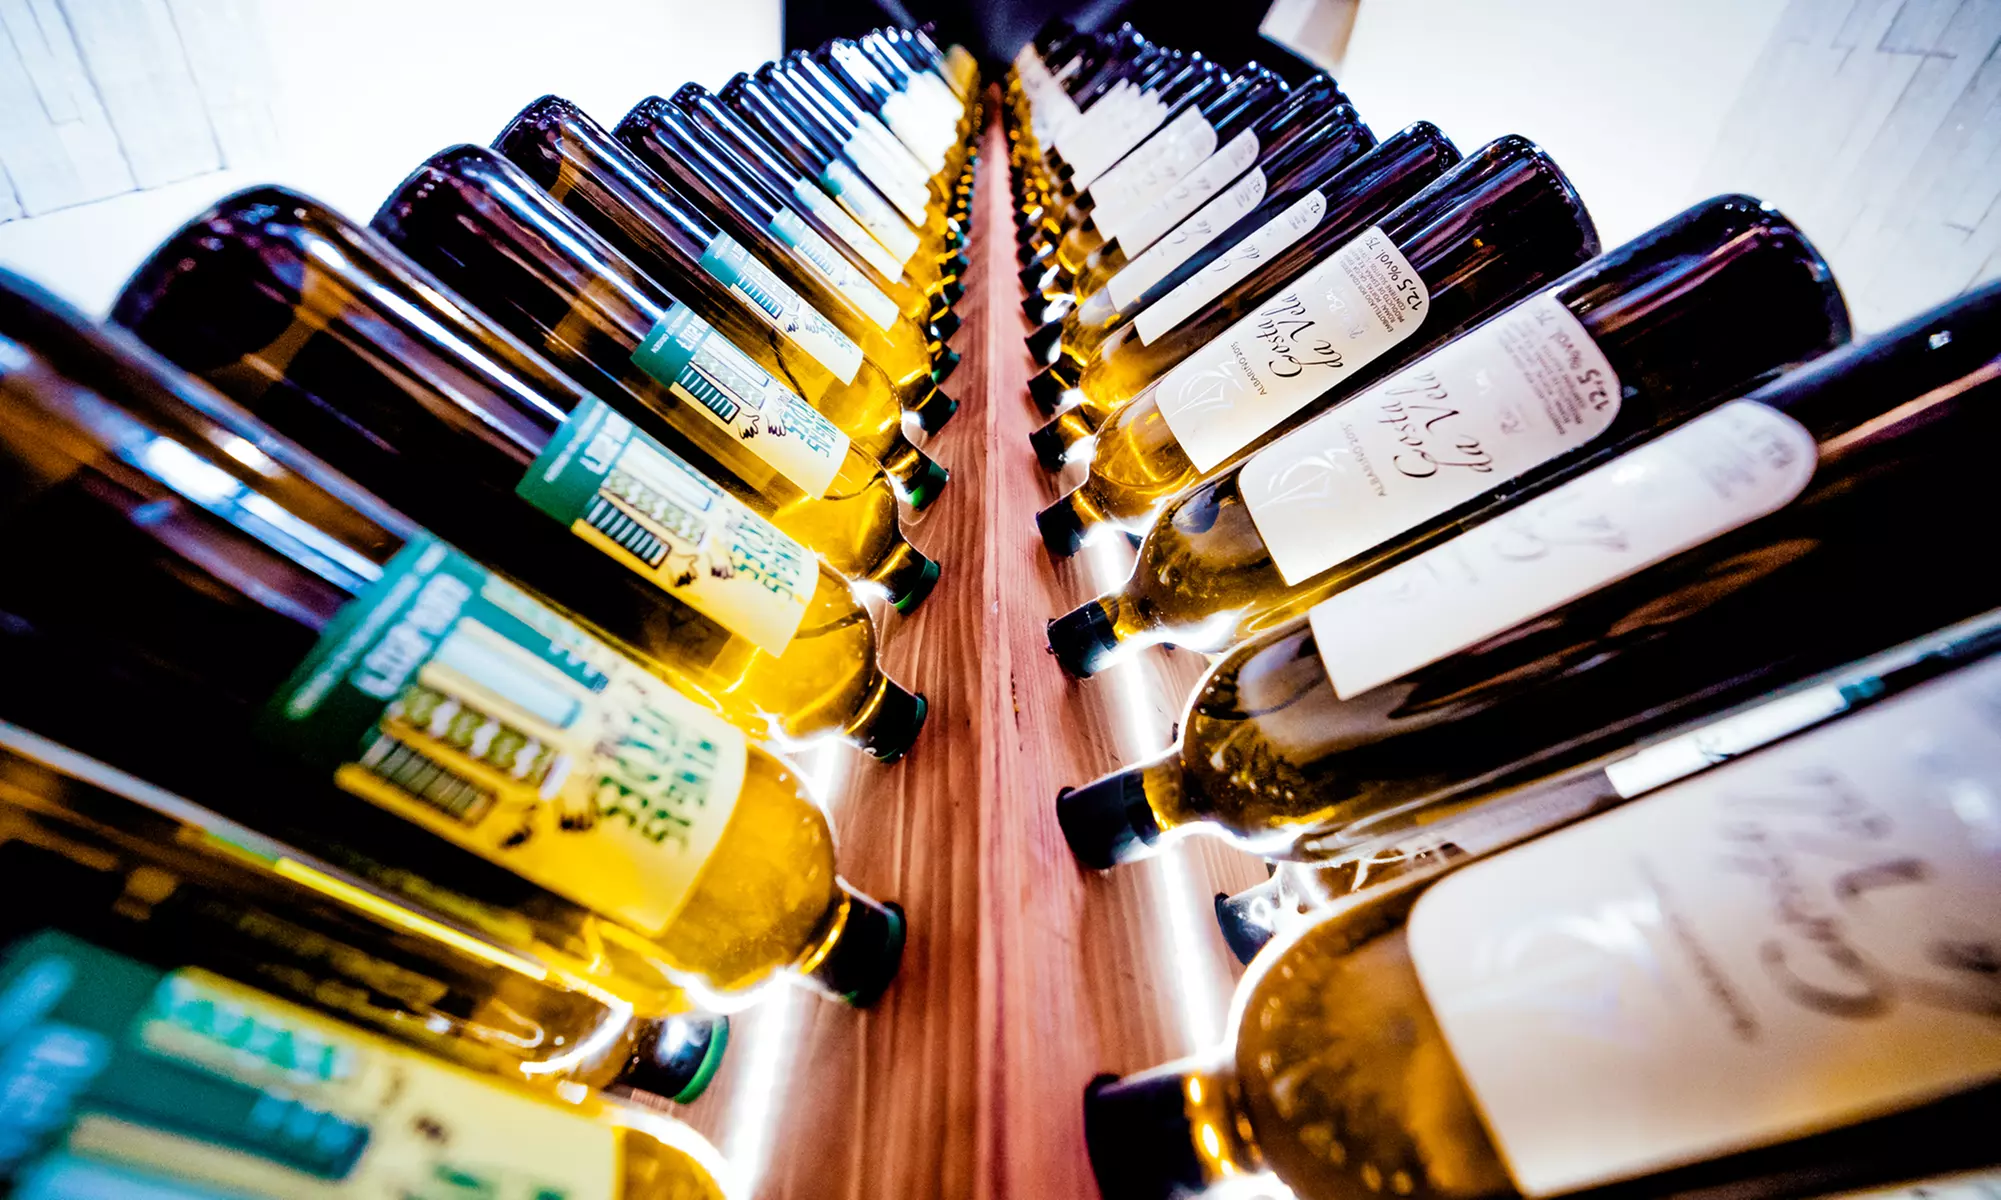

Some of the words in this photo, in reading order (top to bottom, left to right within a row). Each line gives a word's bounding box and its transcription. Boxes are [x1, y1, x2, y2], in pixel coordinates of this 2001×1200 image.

[1397, 278, 1423, 311] 12,5
[1261, 292, 1316, 342] Vela
[1256, 318, 1303, 379] Costa
[1290, 340, 1344, 369] da
[1237, 356, 1268, 396] ALBARIÑO
[1577, 368, 1610, 412] 12,5
[1385, 371, 1460, 434] Vela
[1377, 400, 1439, 479] Costa
[1424, 434, 1494, 473] da
